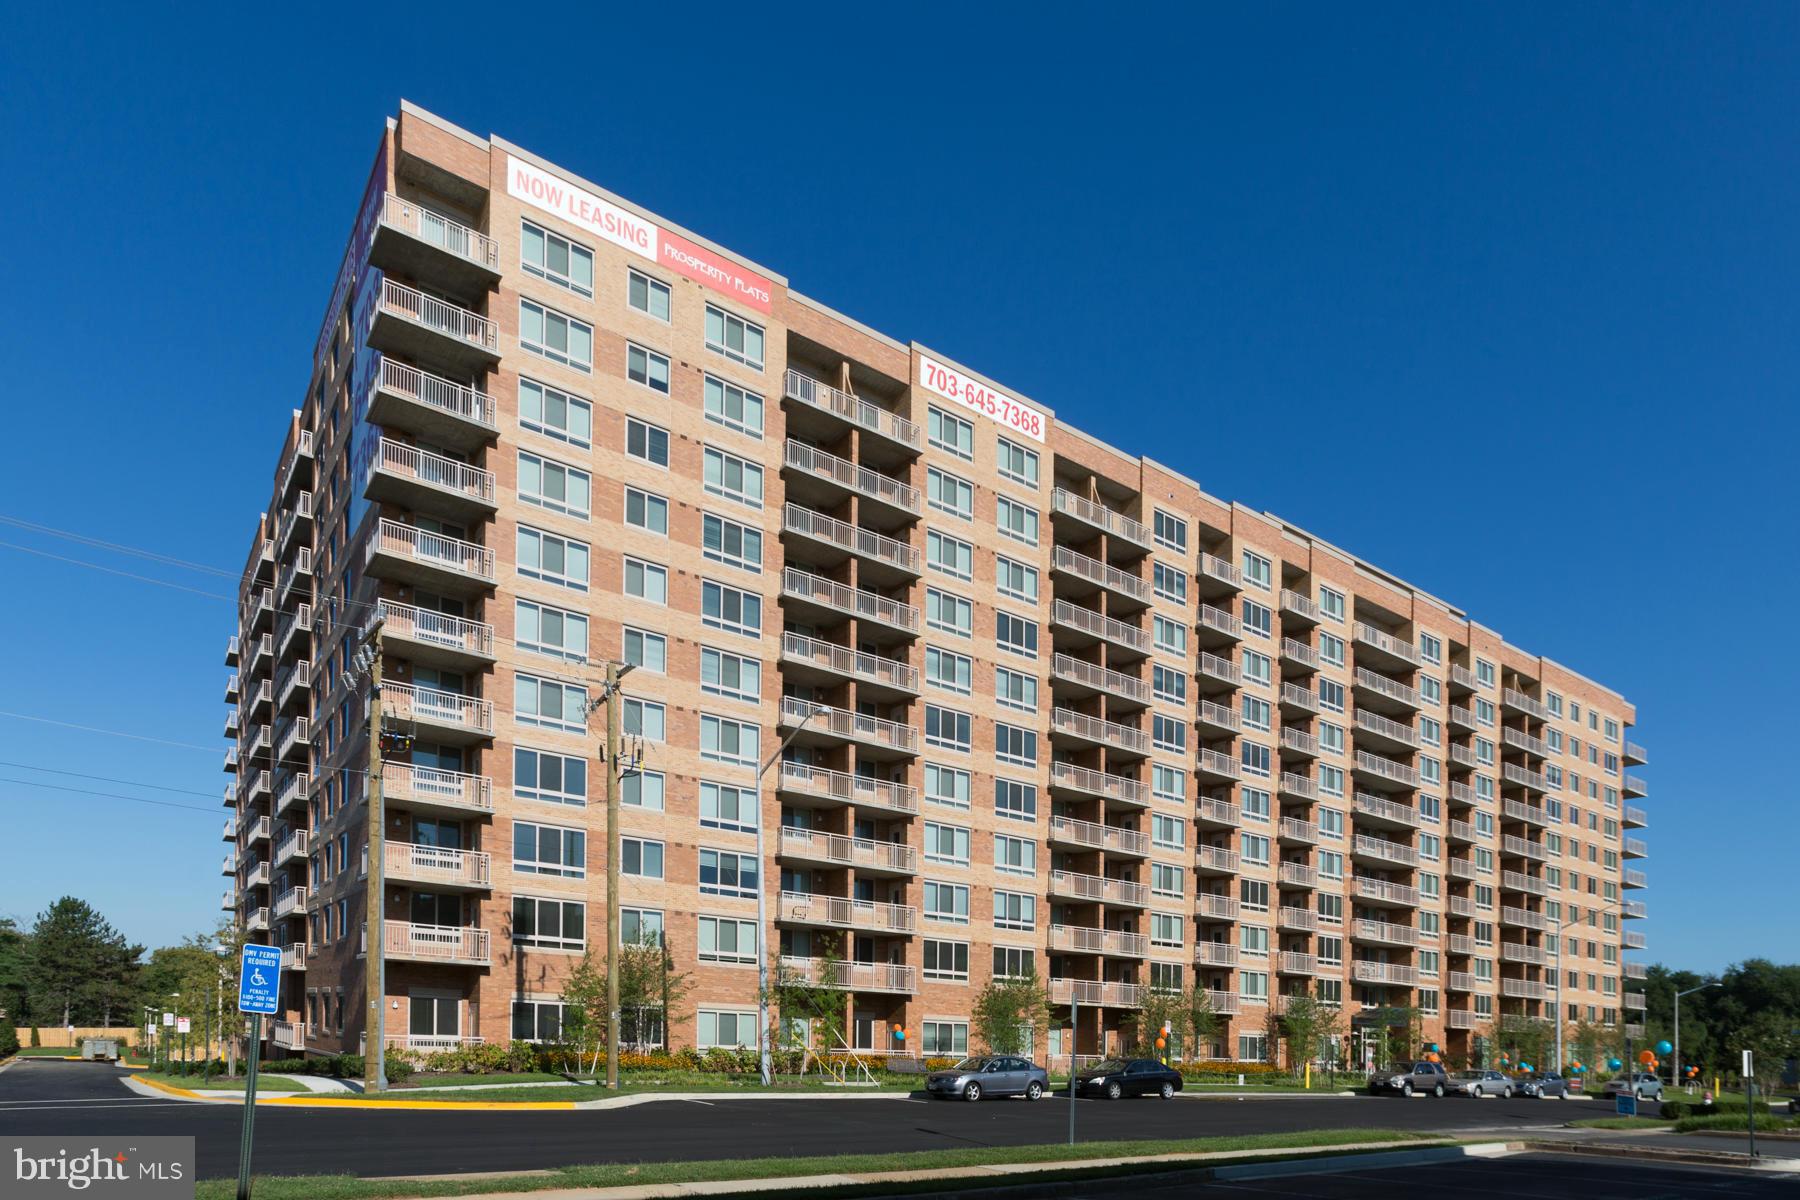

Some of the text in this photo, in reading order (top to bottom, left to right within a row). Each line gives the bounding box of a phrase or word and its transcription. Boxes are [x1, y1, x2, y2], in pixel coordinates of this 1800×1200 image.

[516, 169, 648, 249] NOW LEASING
[664, 243, 770, 303] PROSPERITY FLATS
[927, 363, 1040, 436] 703-645-7368
[248, 958, 275, 966] REQUIRED
[259, 951, 280, 959] PERMIT
